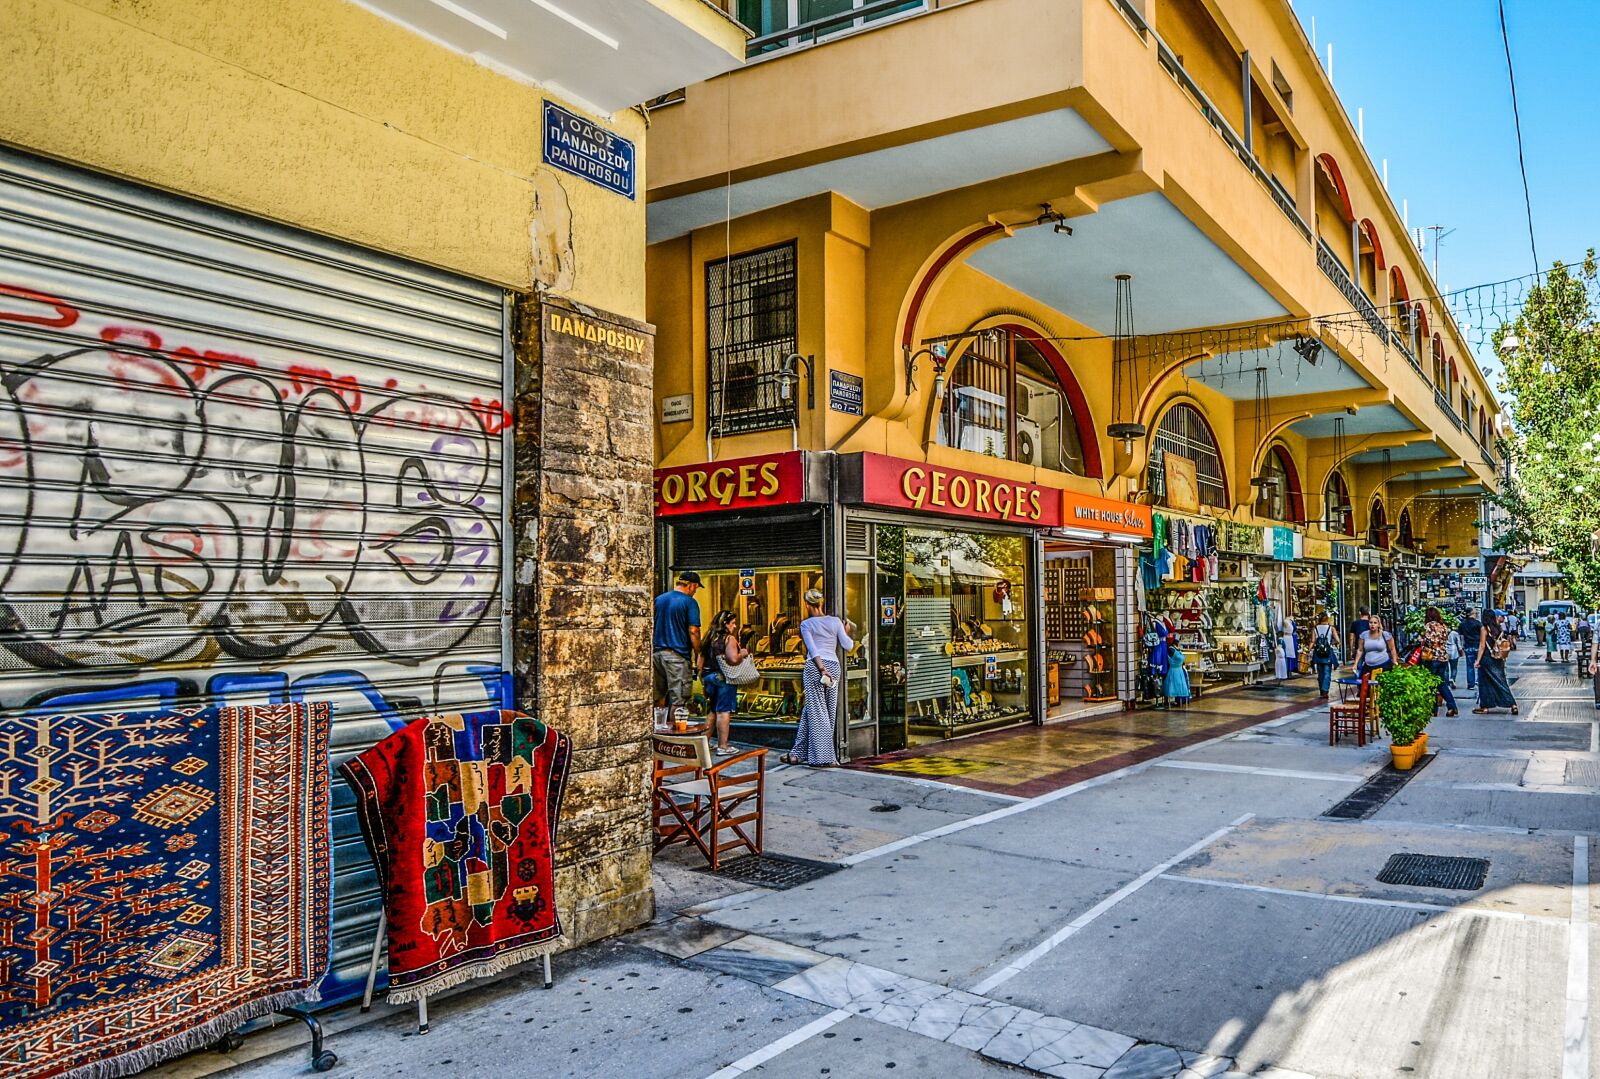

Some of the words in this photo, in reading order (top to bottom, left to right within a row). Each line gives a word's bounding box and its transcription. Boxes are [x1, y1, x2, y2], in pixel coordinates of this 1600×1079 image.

[551, 126, 629, 172] ΠΑΝΔΡΟΣΟΥ
[551, 145, 629, 190] PANDROSOU
[551, 313, 644, 354] ΠΑΝΔΡΟΣΟΥ
[903, 467, 1041, 520] GEORGES
[1075, 505, 1099, 520] WHITE
[1101, 510, 1123, 524] HOUSE
[1431, 558, 1478, 569] ZEUS
